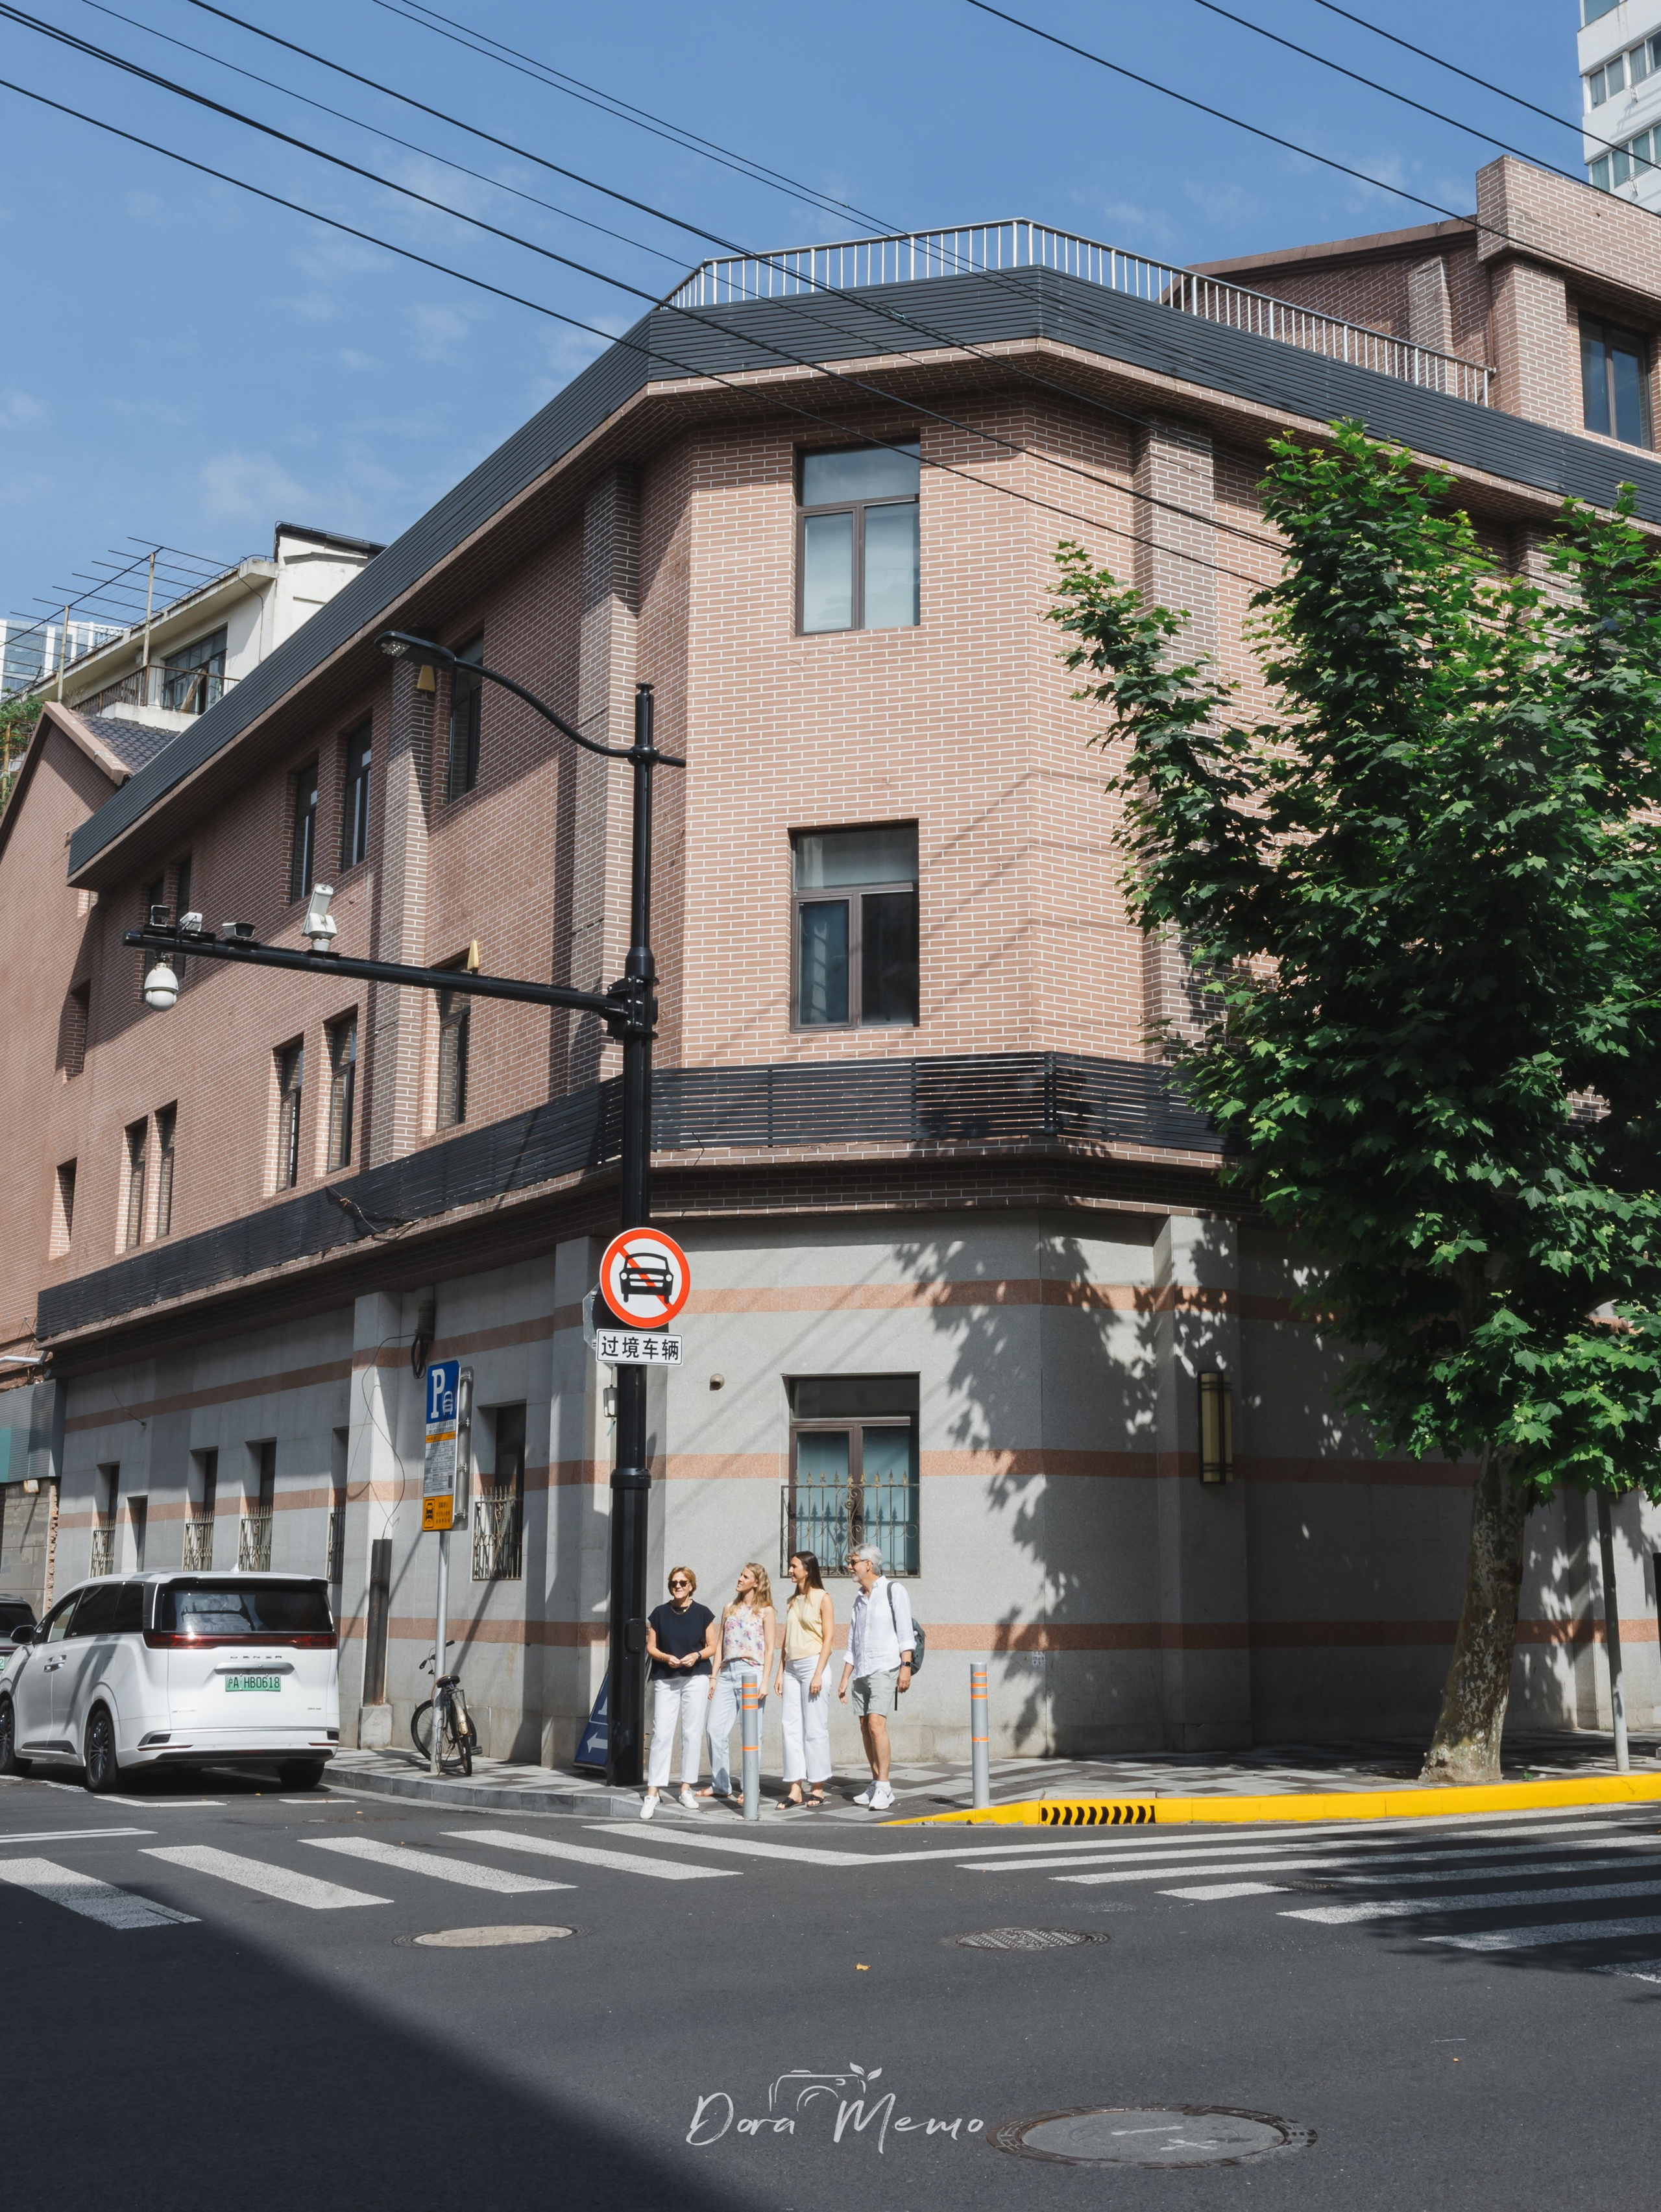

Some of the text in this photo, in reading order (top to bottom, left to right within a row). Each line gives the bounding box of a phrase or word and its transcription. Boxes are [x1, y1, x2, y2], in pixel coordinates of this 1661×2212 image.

[601, 1336, 679, 1361] 过境车辆
[431, 1368, 445, 1419] P
[244, 1677, 280, 1689] HB0618
